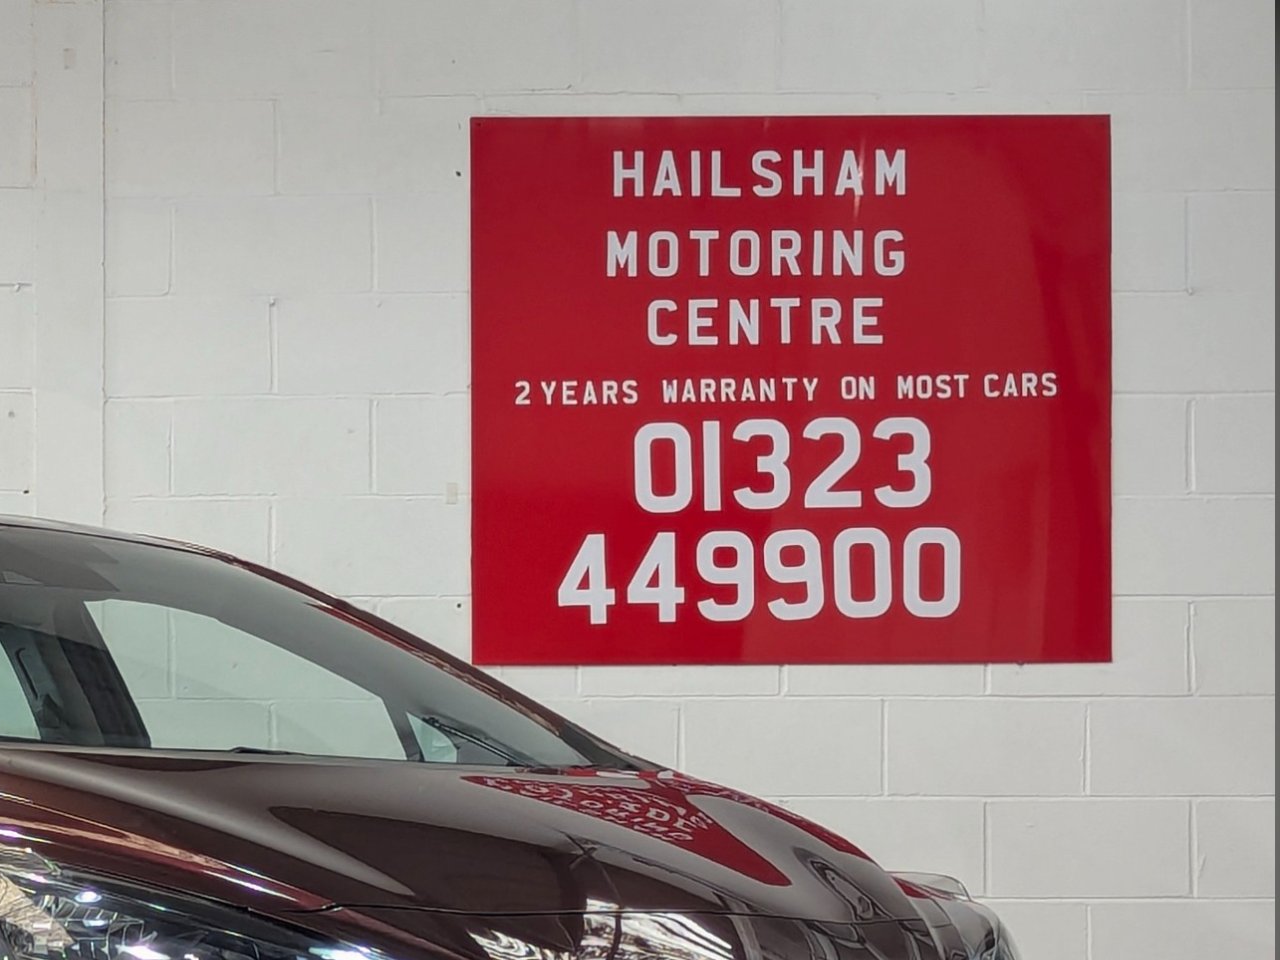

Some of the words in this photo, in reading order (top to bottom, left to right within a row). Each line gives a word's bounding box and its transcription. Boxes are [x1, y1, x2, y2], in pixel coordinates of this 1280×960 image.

[613, 149, 907, 197] HAILSHAM
[606, 229, 906, 277] MOTORING
[647, 297, 884, 346] CENTRE
[515, 380, 531, 405] 2
[540, 379, 638, 405] YEARS
[662, 376, 818, 403] WARRANTY
[841, 376, 875, 401] ON
[897, 374, 970, 400] MOST
[983, 372, 1057, 398] CARS
[633, 416, 932, 514] 01323
[557, 526, 962, 625] 449900
